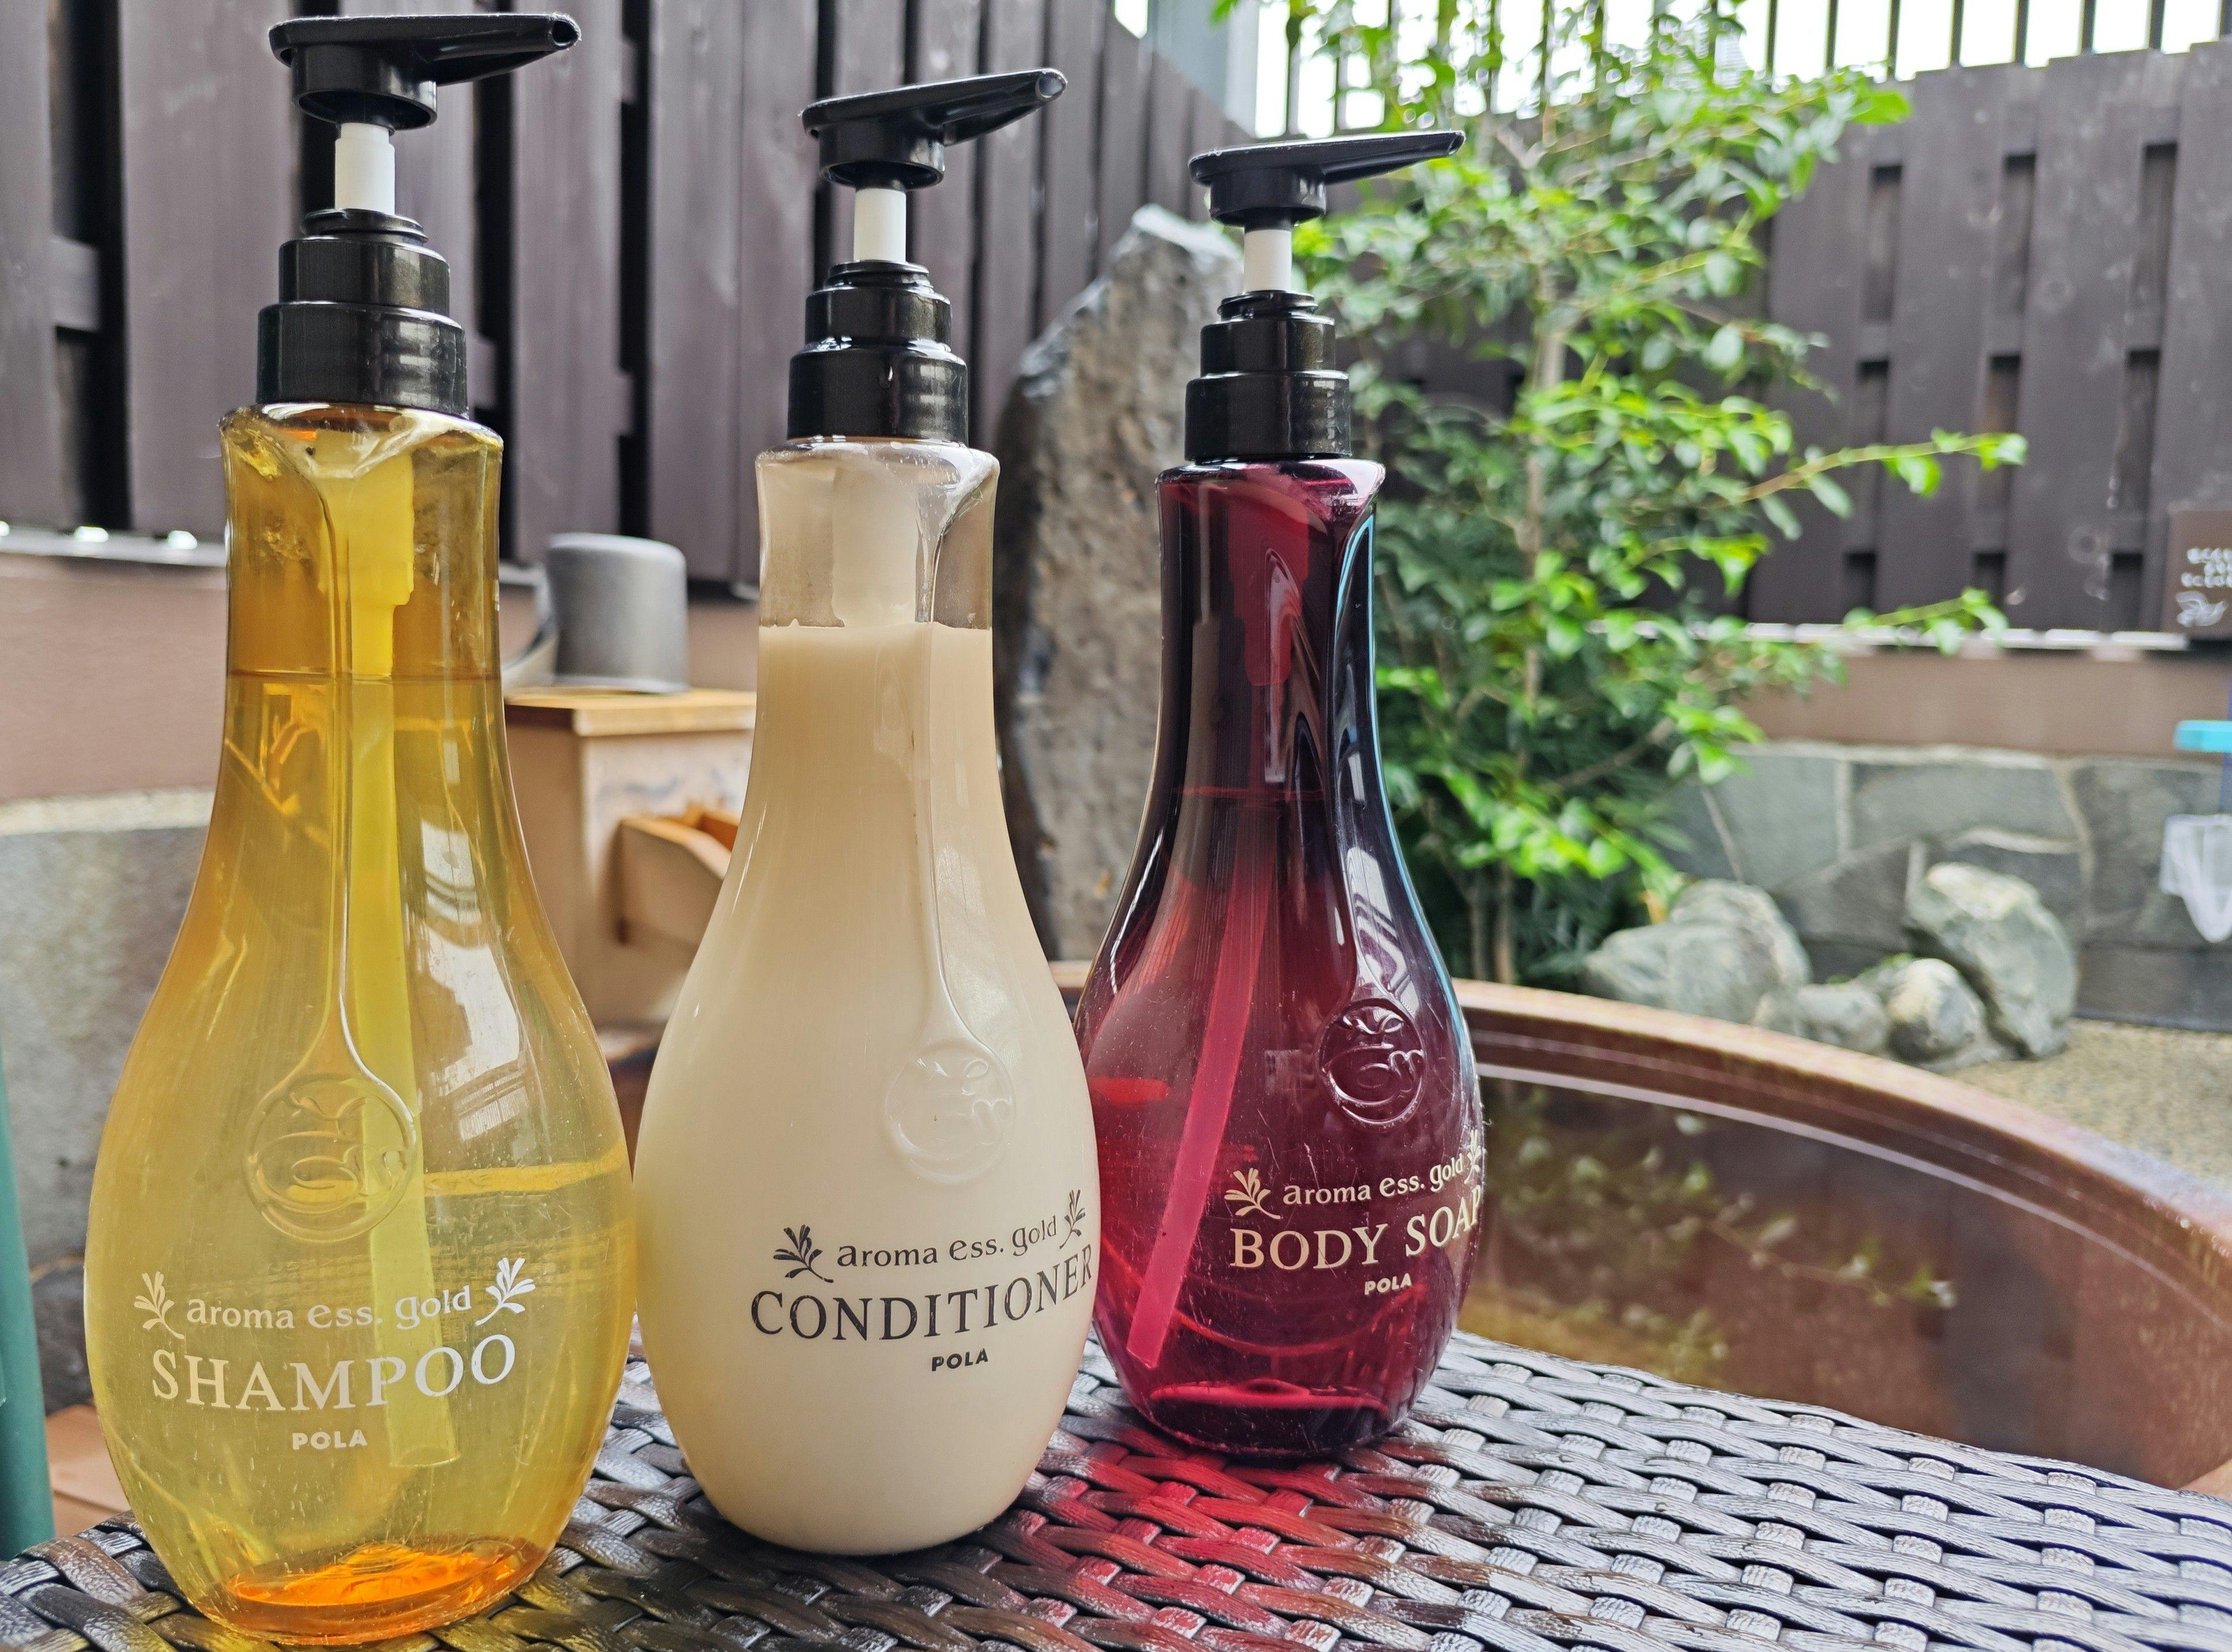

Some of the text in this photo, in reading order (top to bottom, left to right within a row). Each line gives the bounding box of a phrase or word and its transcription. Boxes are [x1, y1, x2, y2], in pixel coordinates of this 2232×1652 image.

[1283, 1158, 1463, 1205] aroma ess. gold
[837, 1214, 1057, 1267] aroma ess. gold
[1229, 1184, 1482, 1270] BODY SOAP
[186, 1285, 472, 1330] aroma ess. gold
[750, 1243, 1094, 1341] CONDITIONER
[1363, 1273, 1412, 1296] POLA
[152, 1334, 516, 1412] SHAMPOO
[931, 1347, 989, 1372] POLA
[292, 1428, 368, 1451] POLA
